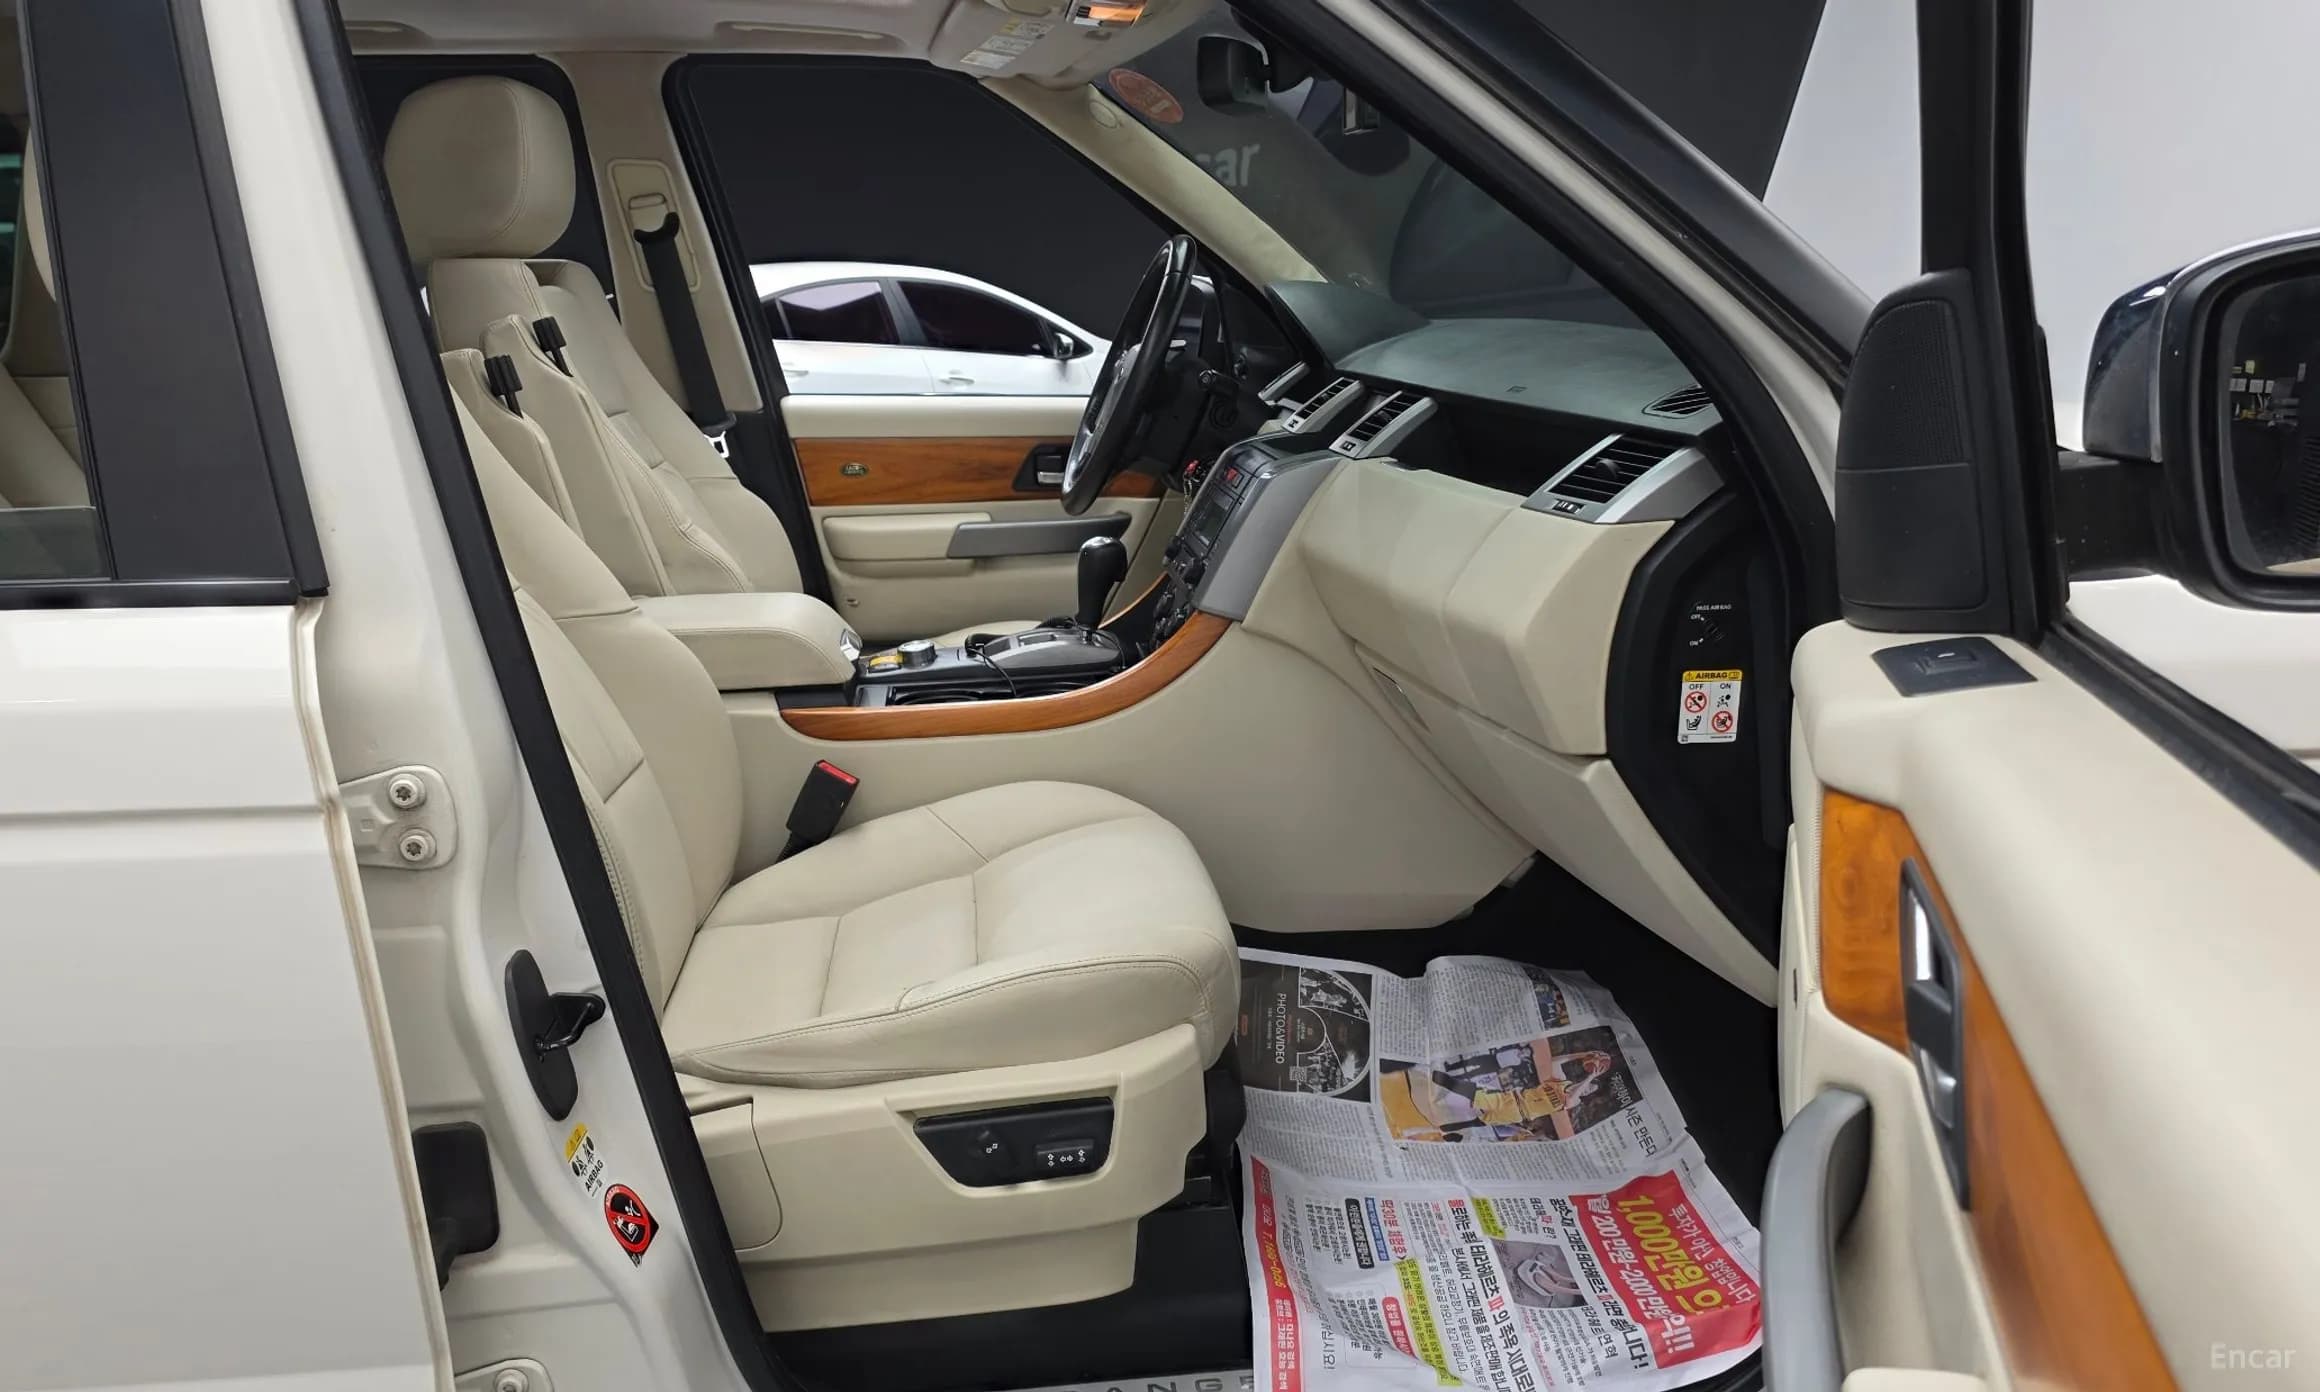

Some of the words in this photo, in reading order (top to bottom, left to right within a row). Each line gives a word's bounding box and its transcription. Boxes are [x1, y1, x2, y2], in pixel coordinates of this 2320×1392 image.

[1689, 683, 1704, 691] OFF
[1695, 672, 1728, 680] AIRBAG
[1275, 993, 1286, 1064] PHOTO&VIDEO
[1624, 1106, 1643, 1126] 시즌
[1632, 1127, 1658, 1158] 만든다
[584, 1159, 604, 1192] AIRBAG
[1563, 1228, 1587, 1252] 그래핀
[1617, 1195, 1711, 1291] 1,000만원
[1675, 1289, 1727, 1315] 으
[1669, 1204, 1698, 1239] 투자가
[1690, 1239, 1715, 1260] 아닌
[1705, 1258, 1756, 1303] 창업입니다
